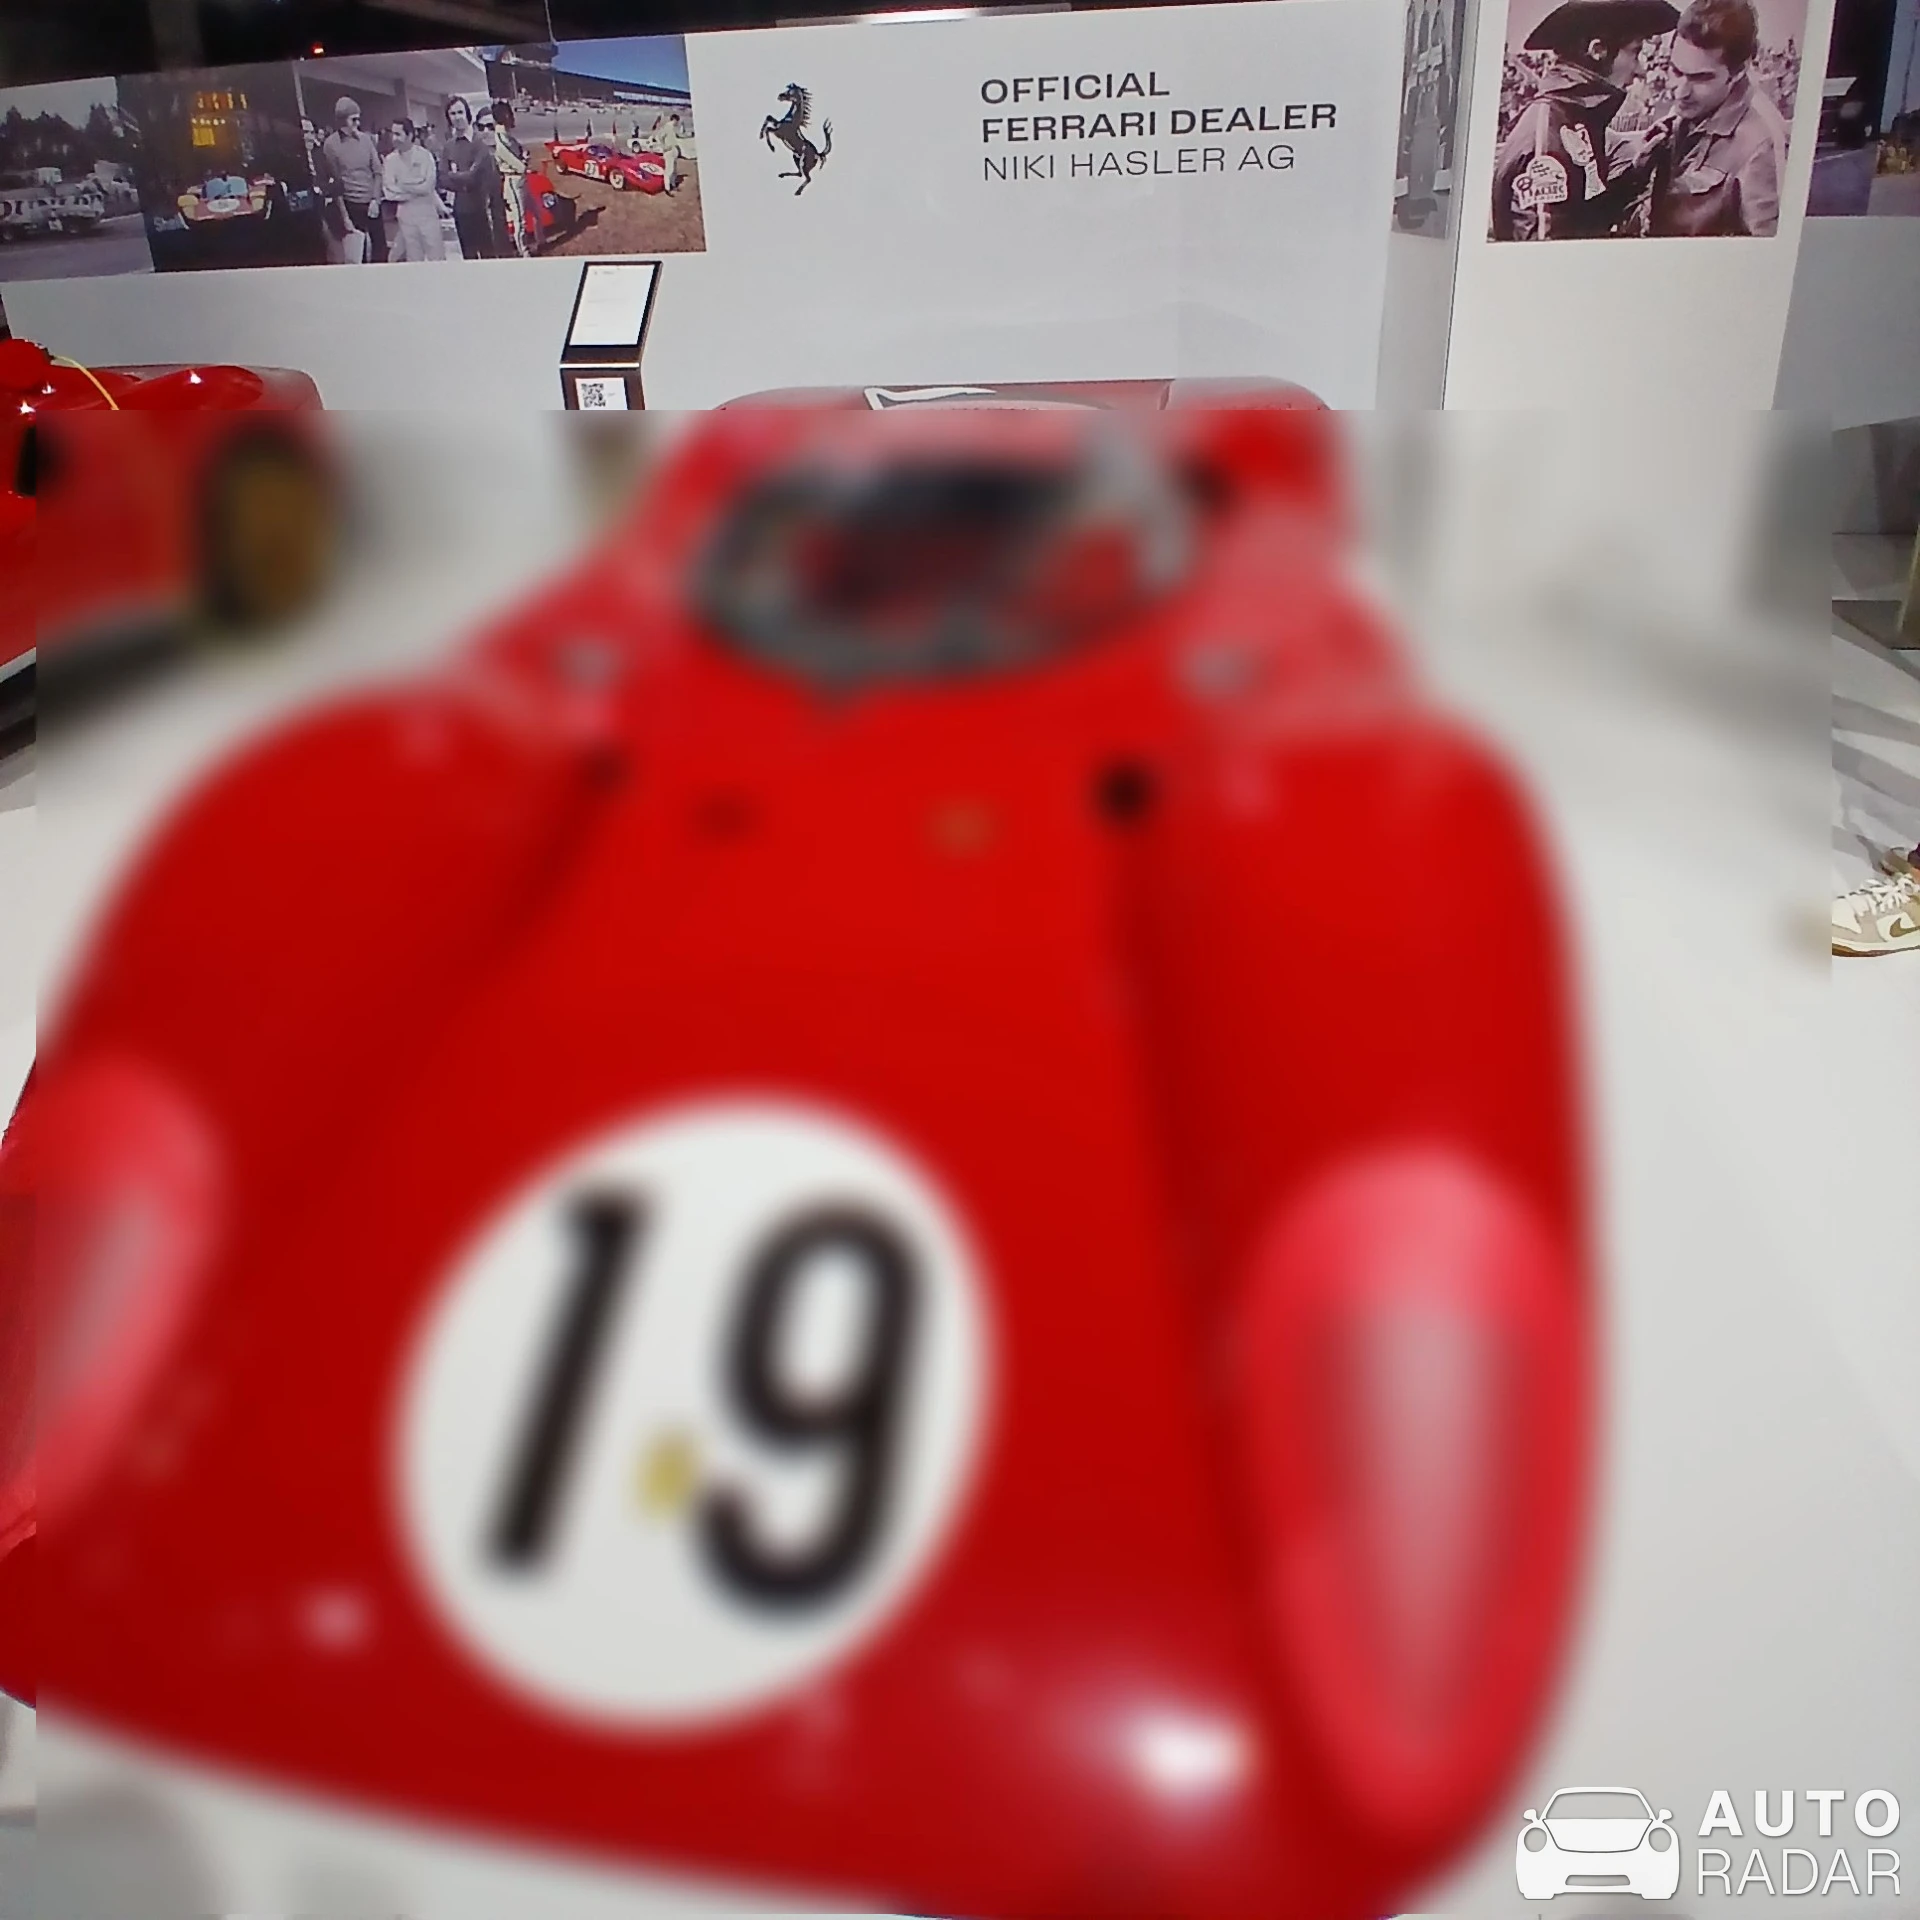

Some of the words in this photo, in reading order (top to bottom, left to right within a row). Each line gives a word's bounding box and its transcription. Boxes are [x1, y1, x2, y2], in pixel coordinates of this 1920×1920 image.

[981, 71, 1170, 105] OFFICIAL
[982, 111, 1156, 143] FERRARI
[1170, 103, 1337, 135] DEALER
[984, 154, 1055, 181] NIKI
[1071, 147, 1226, 178] HASLER
[1237, 144, 1295, 172] AG
[486, 1186, 922, 1622] 19
